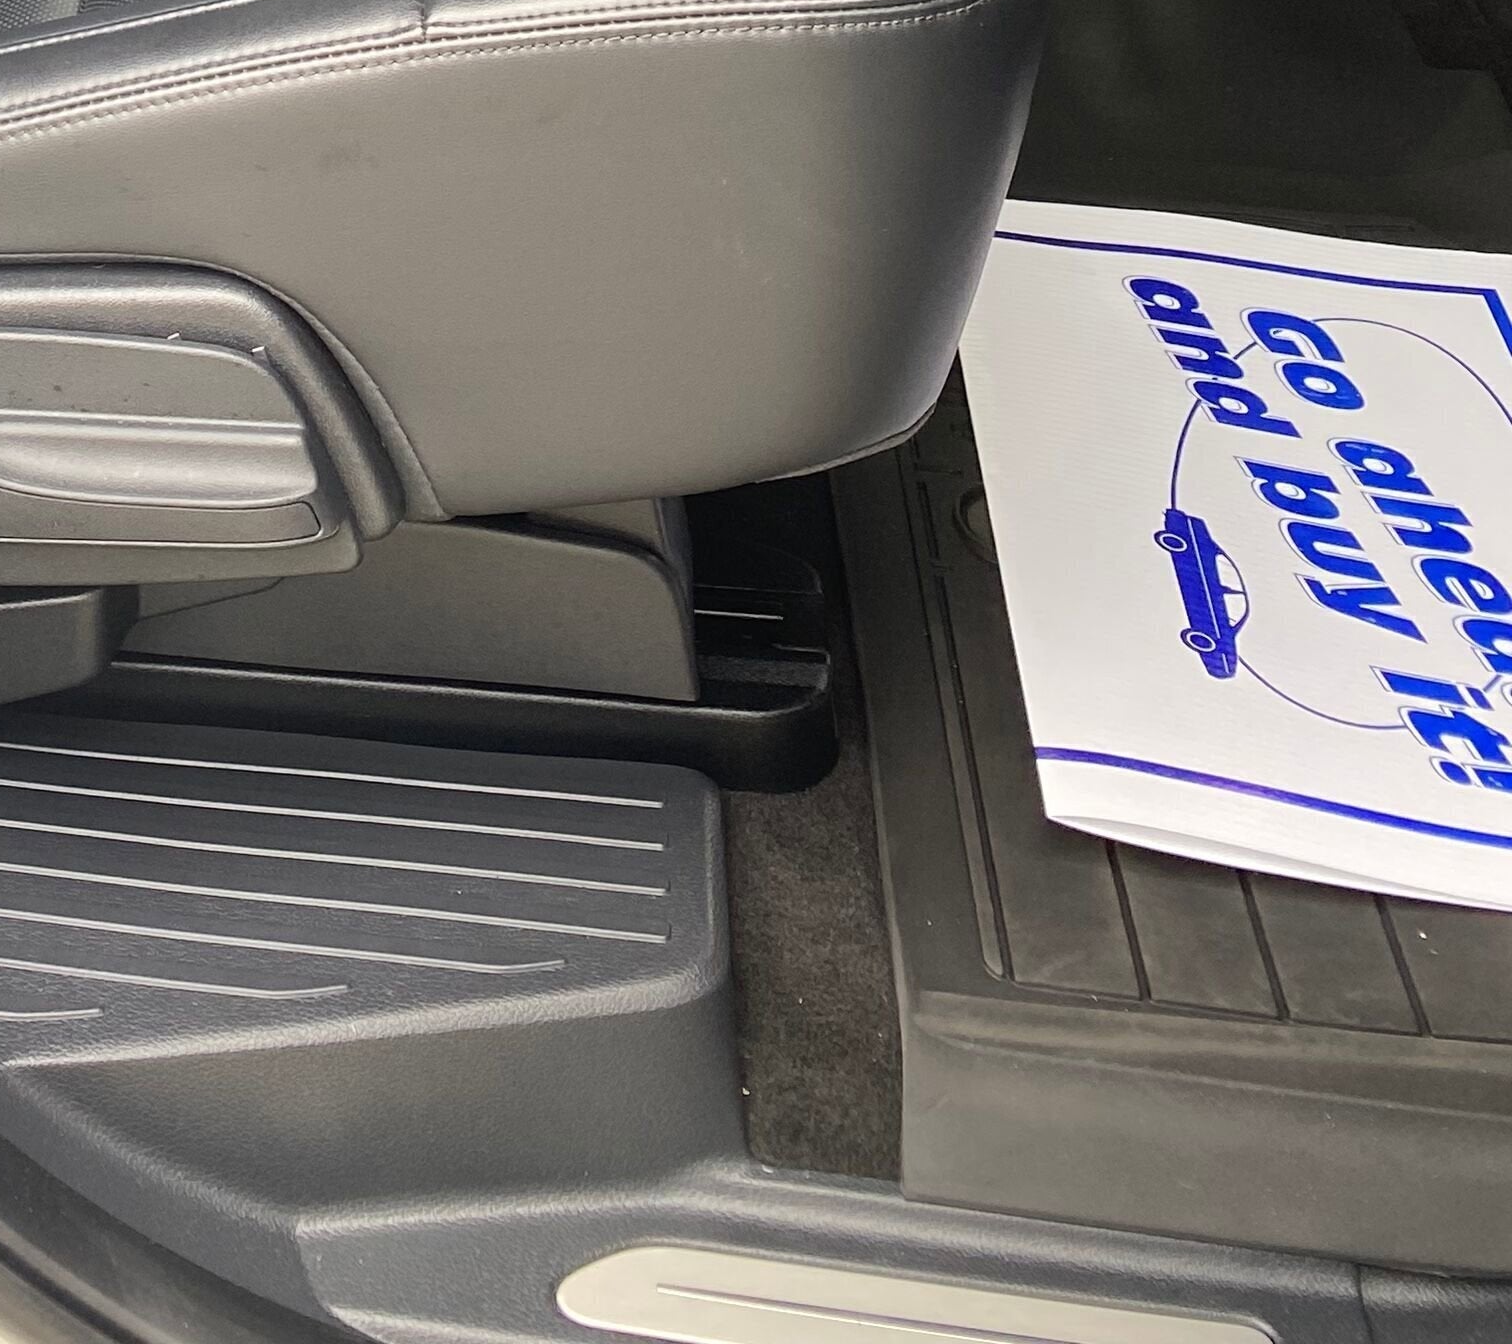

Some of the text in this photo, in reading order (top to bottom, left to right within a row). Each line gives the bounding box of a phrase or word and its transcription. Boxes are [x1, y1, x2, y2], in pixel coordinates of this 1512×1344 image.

[1123, 275, 1302, 439] and
[1238, 457, 1429, 645] buy
[1242, 308, 1364, 412] Go
